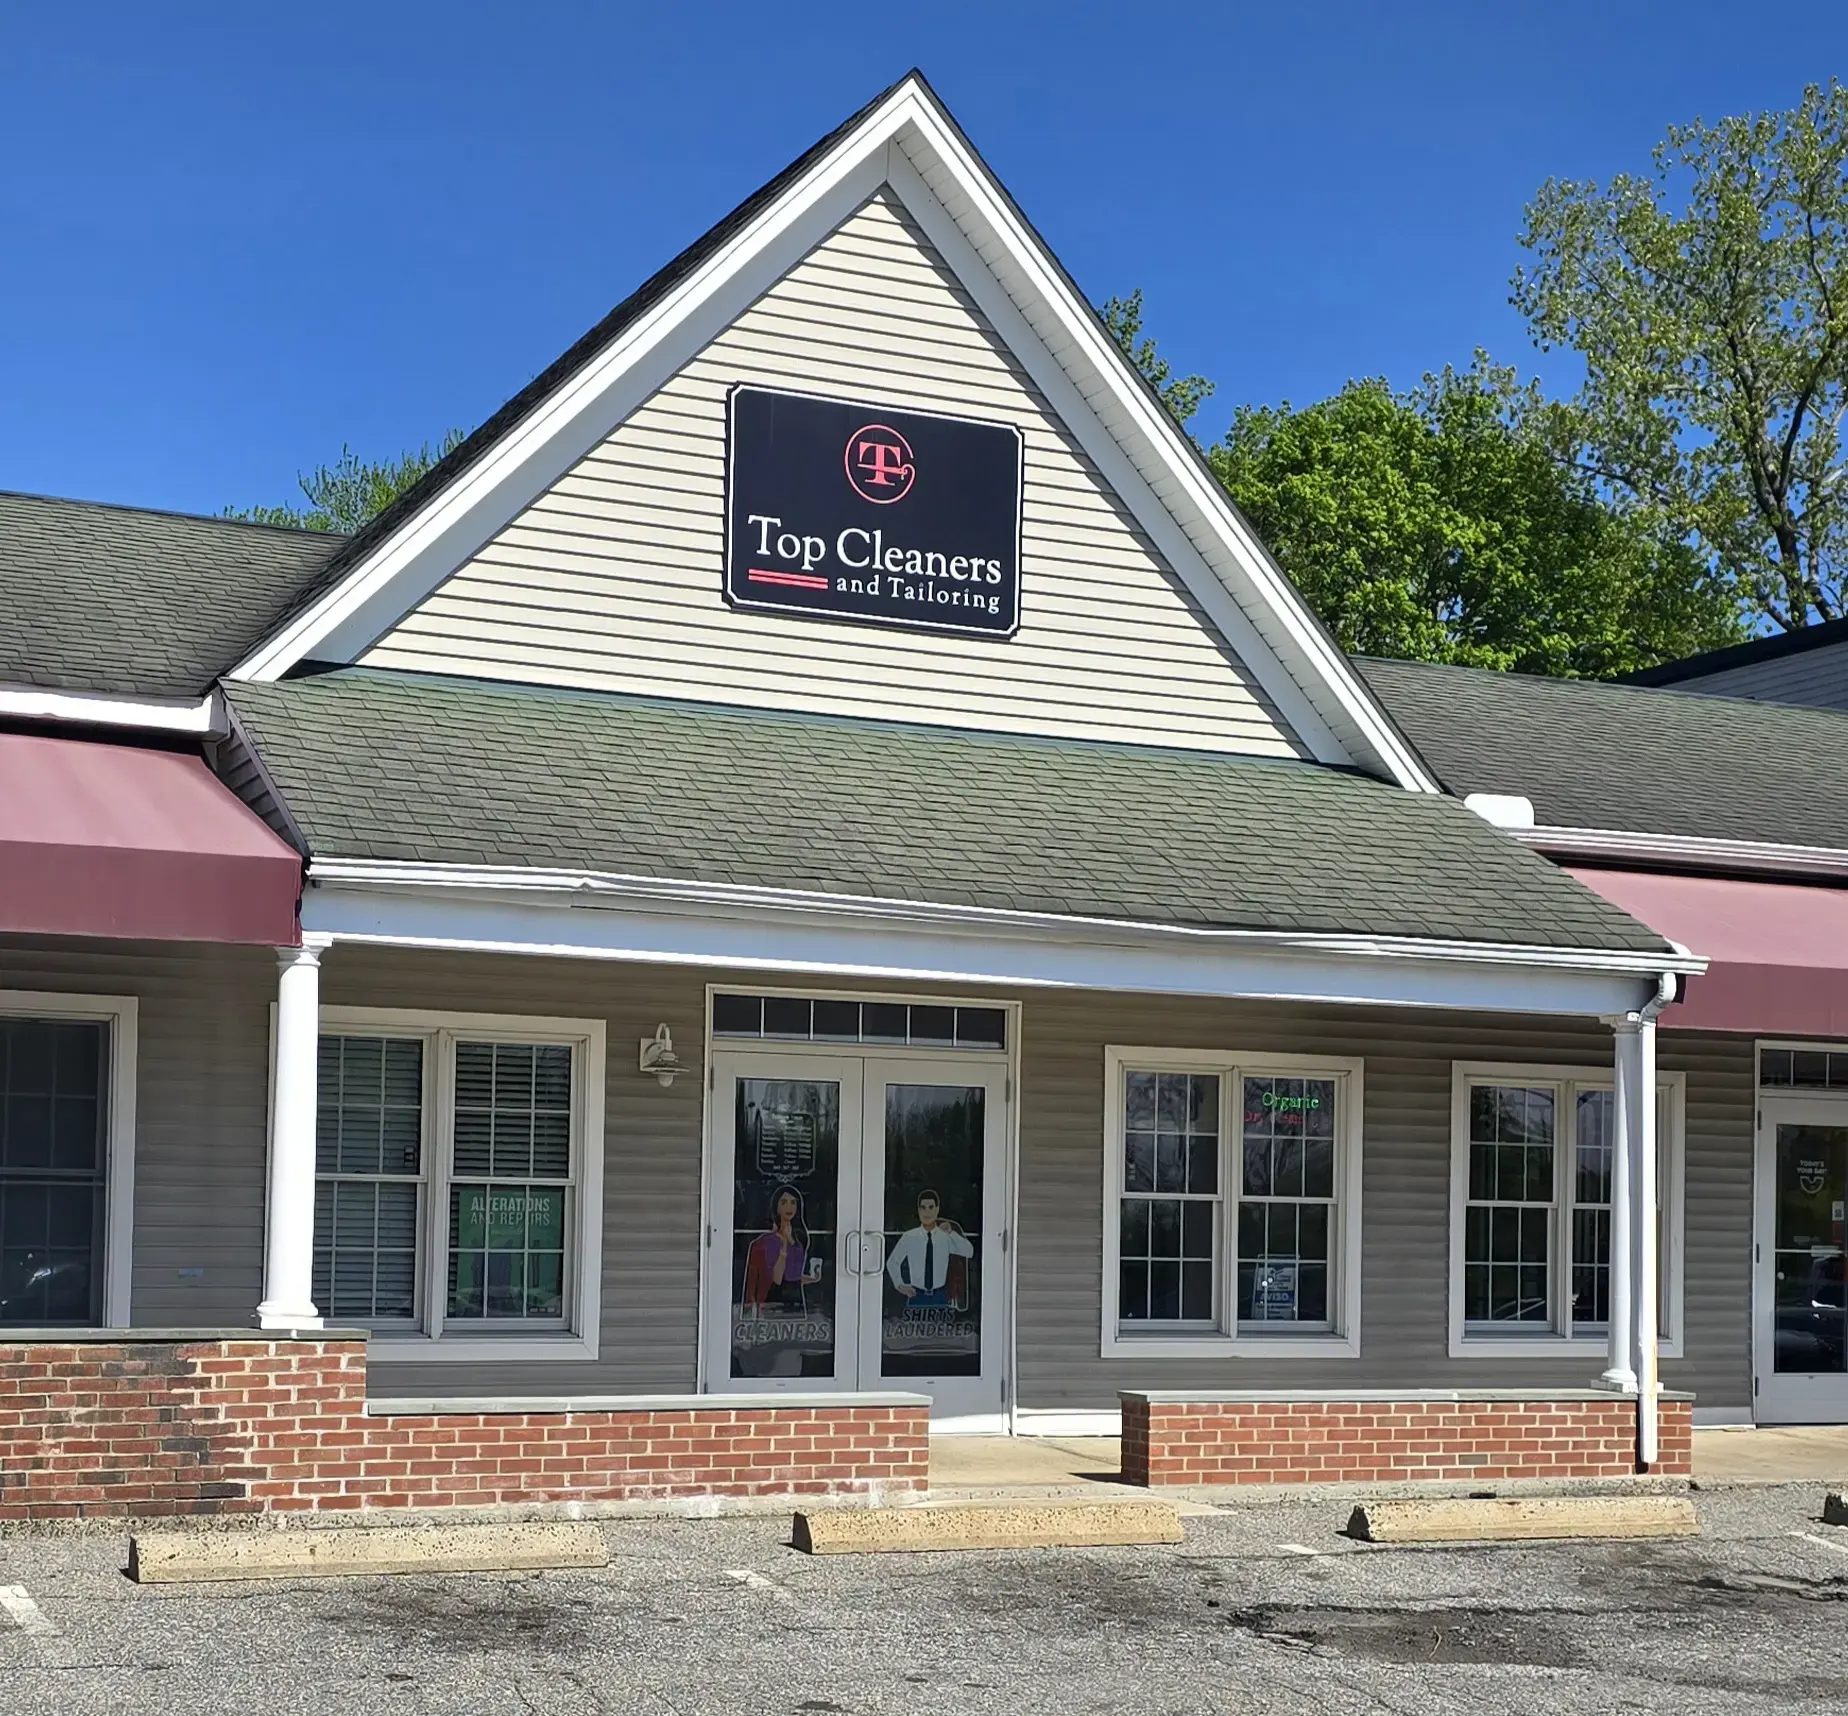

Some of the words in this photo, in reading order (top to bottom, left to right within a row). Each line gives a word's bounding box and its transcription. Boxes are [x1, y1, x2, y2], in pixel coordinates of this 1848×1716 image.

[748, 515, 826, 571] Top
[836, 528, 1002, 584] Cleaners
[836, 576, 880, 596] and
[888, 577, 1000, 614] Tailoring
[1262, 1092, 1319, 1111] Organic
[500, 1212, 550, 1225] REPIRS
[734, 1322, 830, 1341] CLEANERS
